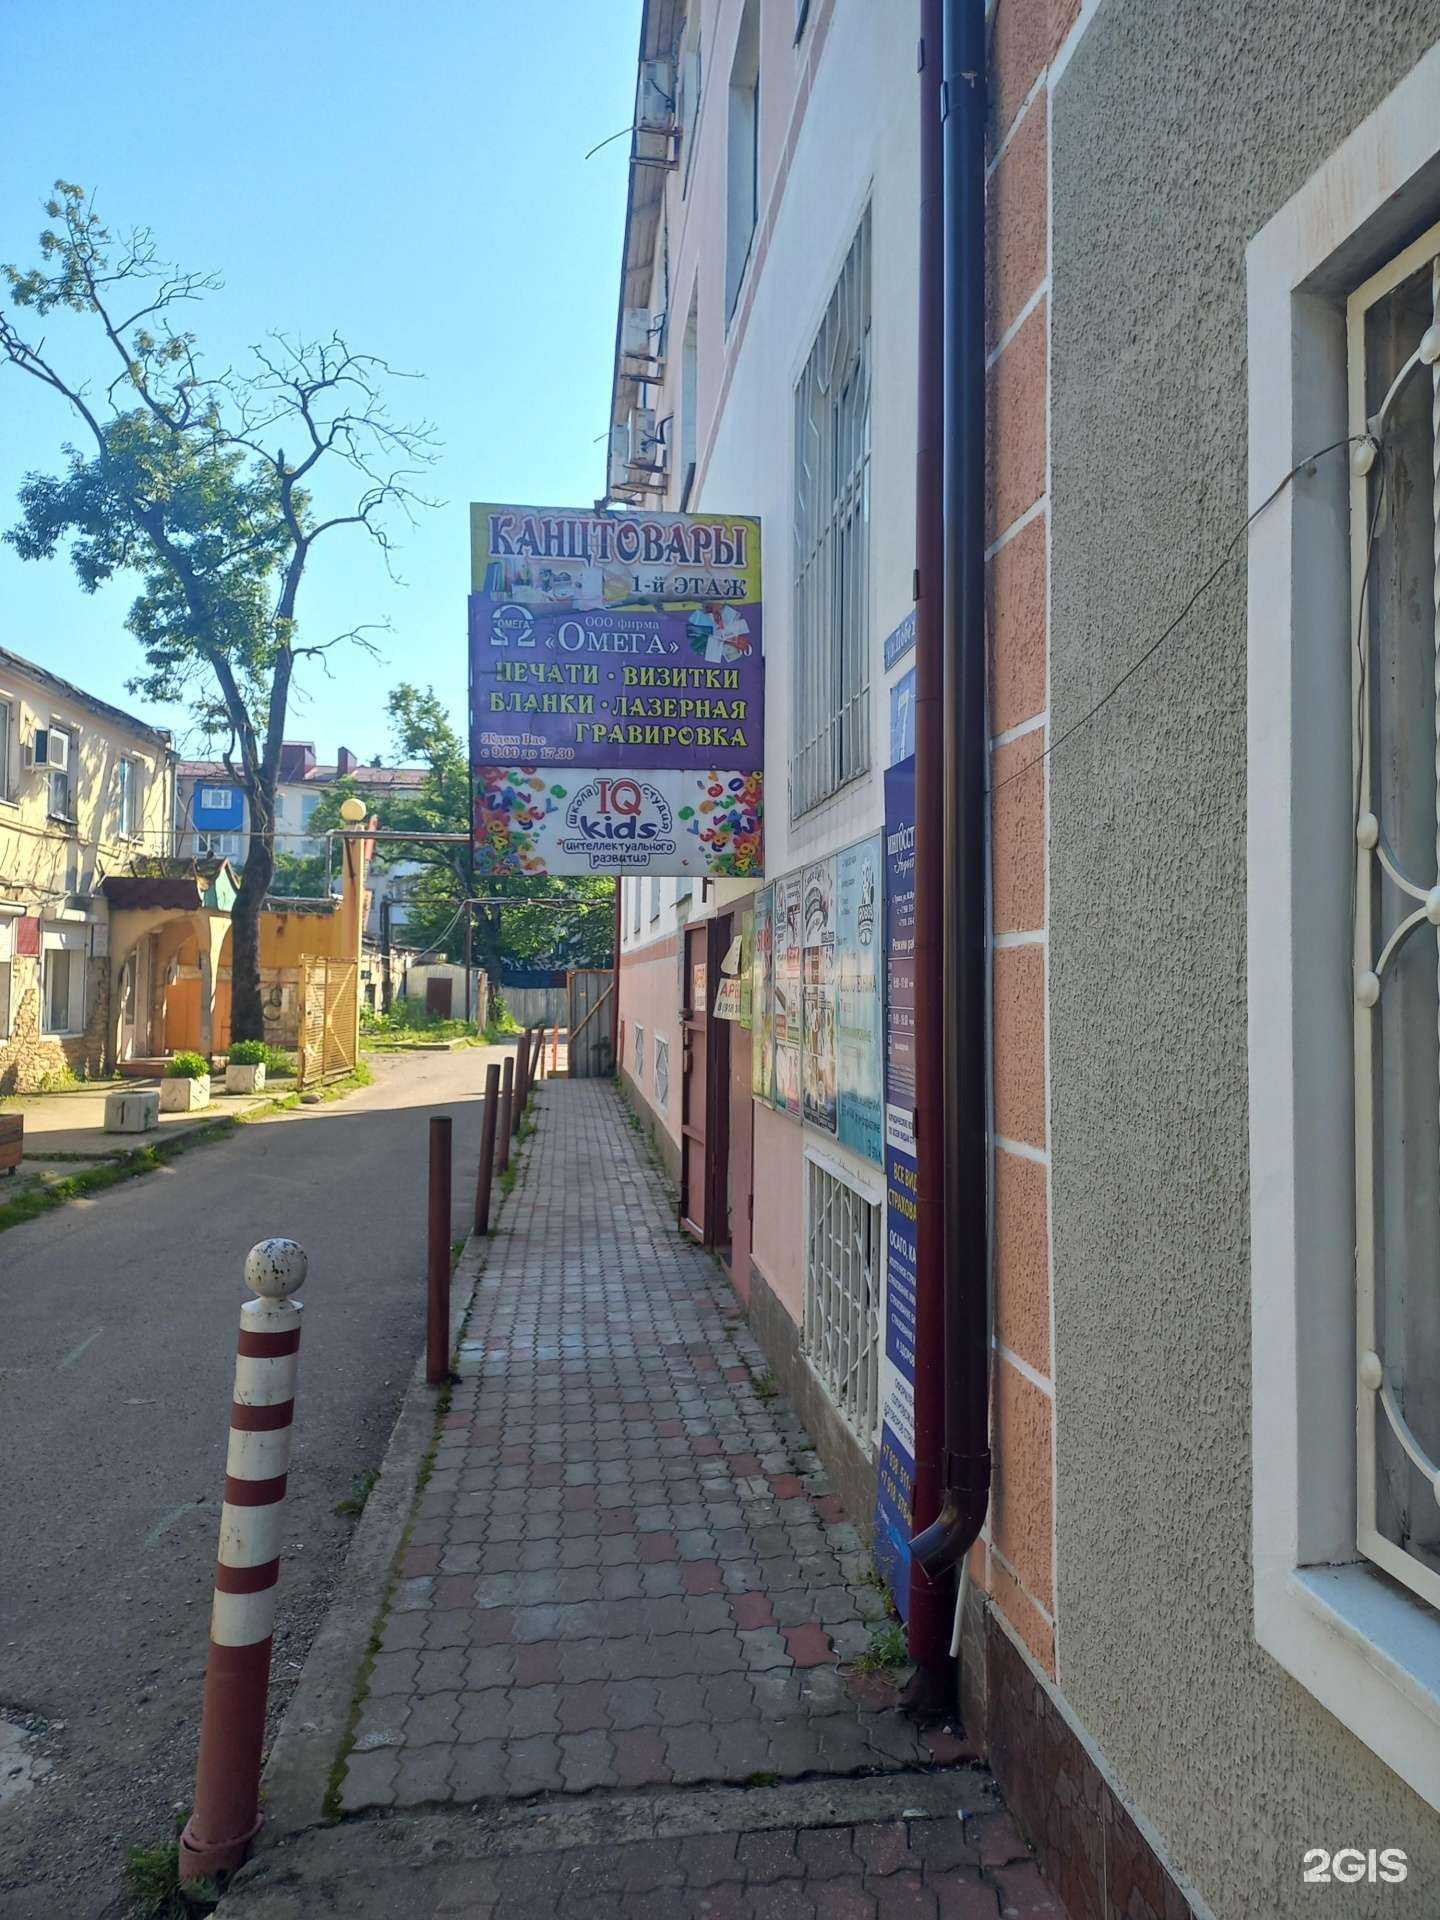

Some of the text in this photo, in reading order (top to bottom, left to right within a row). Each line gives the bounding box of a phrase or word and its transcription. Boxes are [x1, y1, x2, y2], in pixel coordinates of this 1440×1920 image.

[489, 515, 748, 567] КАНЦТОВАРЫ
[632, 576, 748, 598] 1-й ЭТАЖ
[585, 616, 661, 631] ООО фирма
[496, 661, 739, 690] ПЕЧАТИ ВИЗИТКИ
[488, 691, 747, 721] БЛАНКИ ЛАЗЕРНАЯ
[521, 733, 546, 746] Вас
[575, 722, 748, 748] ГРАВИРОВКА
[491, 747, 519, 759] 9.00
[520, 749, 537, 760] до
[539, 747, 575, 761] 17.30
[569, 787, 594, 825] школа
[596, 780, 642, 816] IQ
[580, 815, 658, 840] kids
[566, 841, 673, 854] интеллектуального
[592, 854, 648, 866] развития
[894, 1161, 905, 1184] ВСЕ
